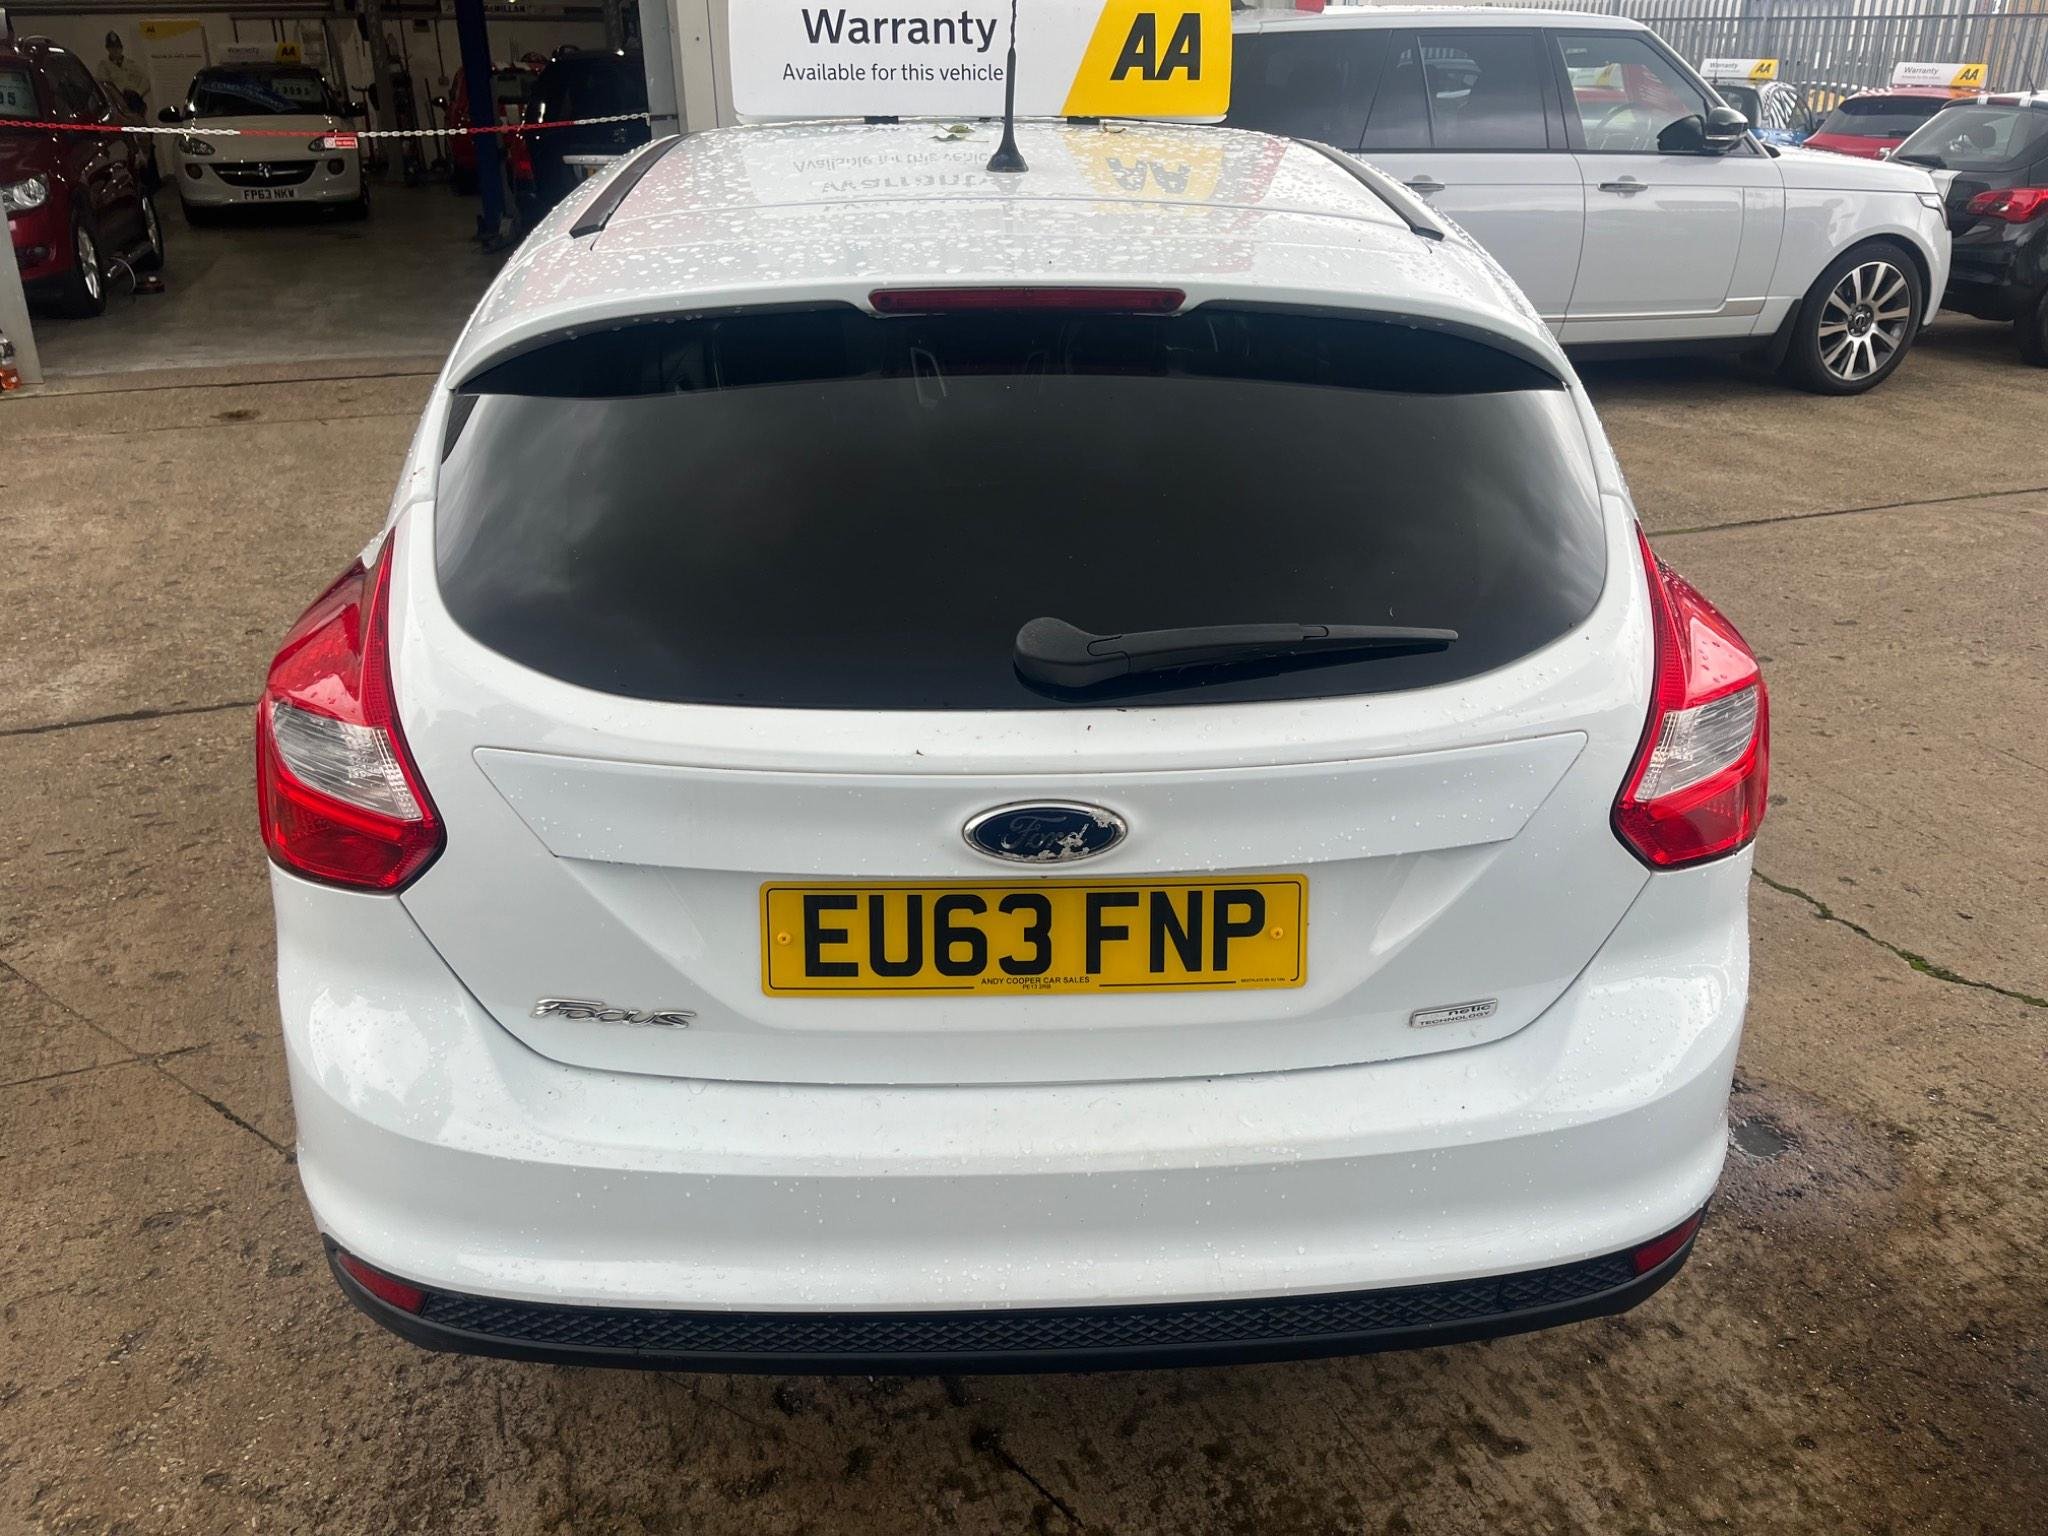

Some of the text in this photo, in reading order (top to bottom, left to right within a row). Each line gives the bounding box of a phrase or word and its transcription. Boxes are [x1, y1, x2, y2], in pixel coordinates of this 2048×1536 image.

[801, 8, 998, 53] Warranty
[1109, 12, 1201, 81] AA
[782, 63, 1004, 81] Available for this vehicle
[1755, 63, 1772, 73] AA
[1904, 66, 1939, 75] Warranty
[1959, 68, 1979, 81] AA
[243, 189, 272, 200] FP63
[803, 889, 1266, 978] EU63 FNP
[981, 976, 1090, 985] ANDY COOPER CAR SALES
[1419, 1011, 1490, 1026] TECHNOLOGY
